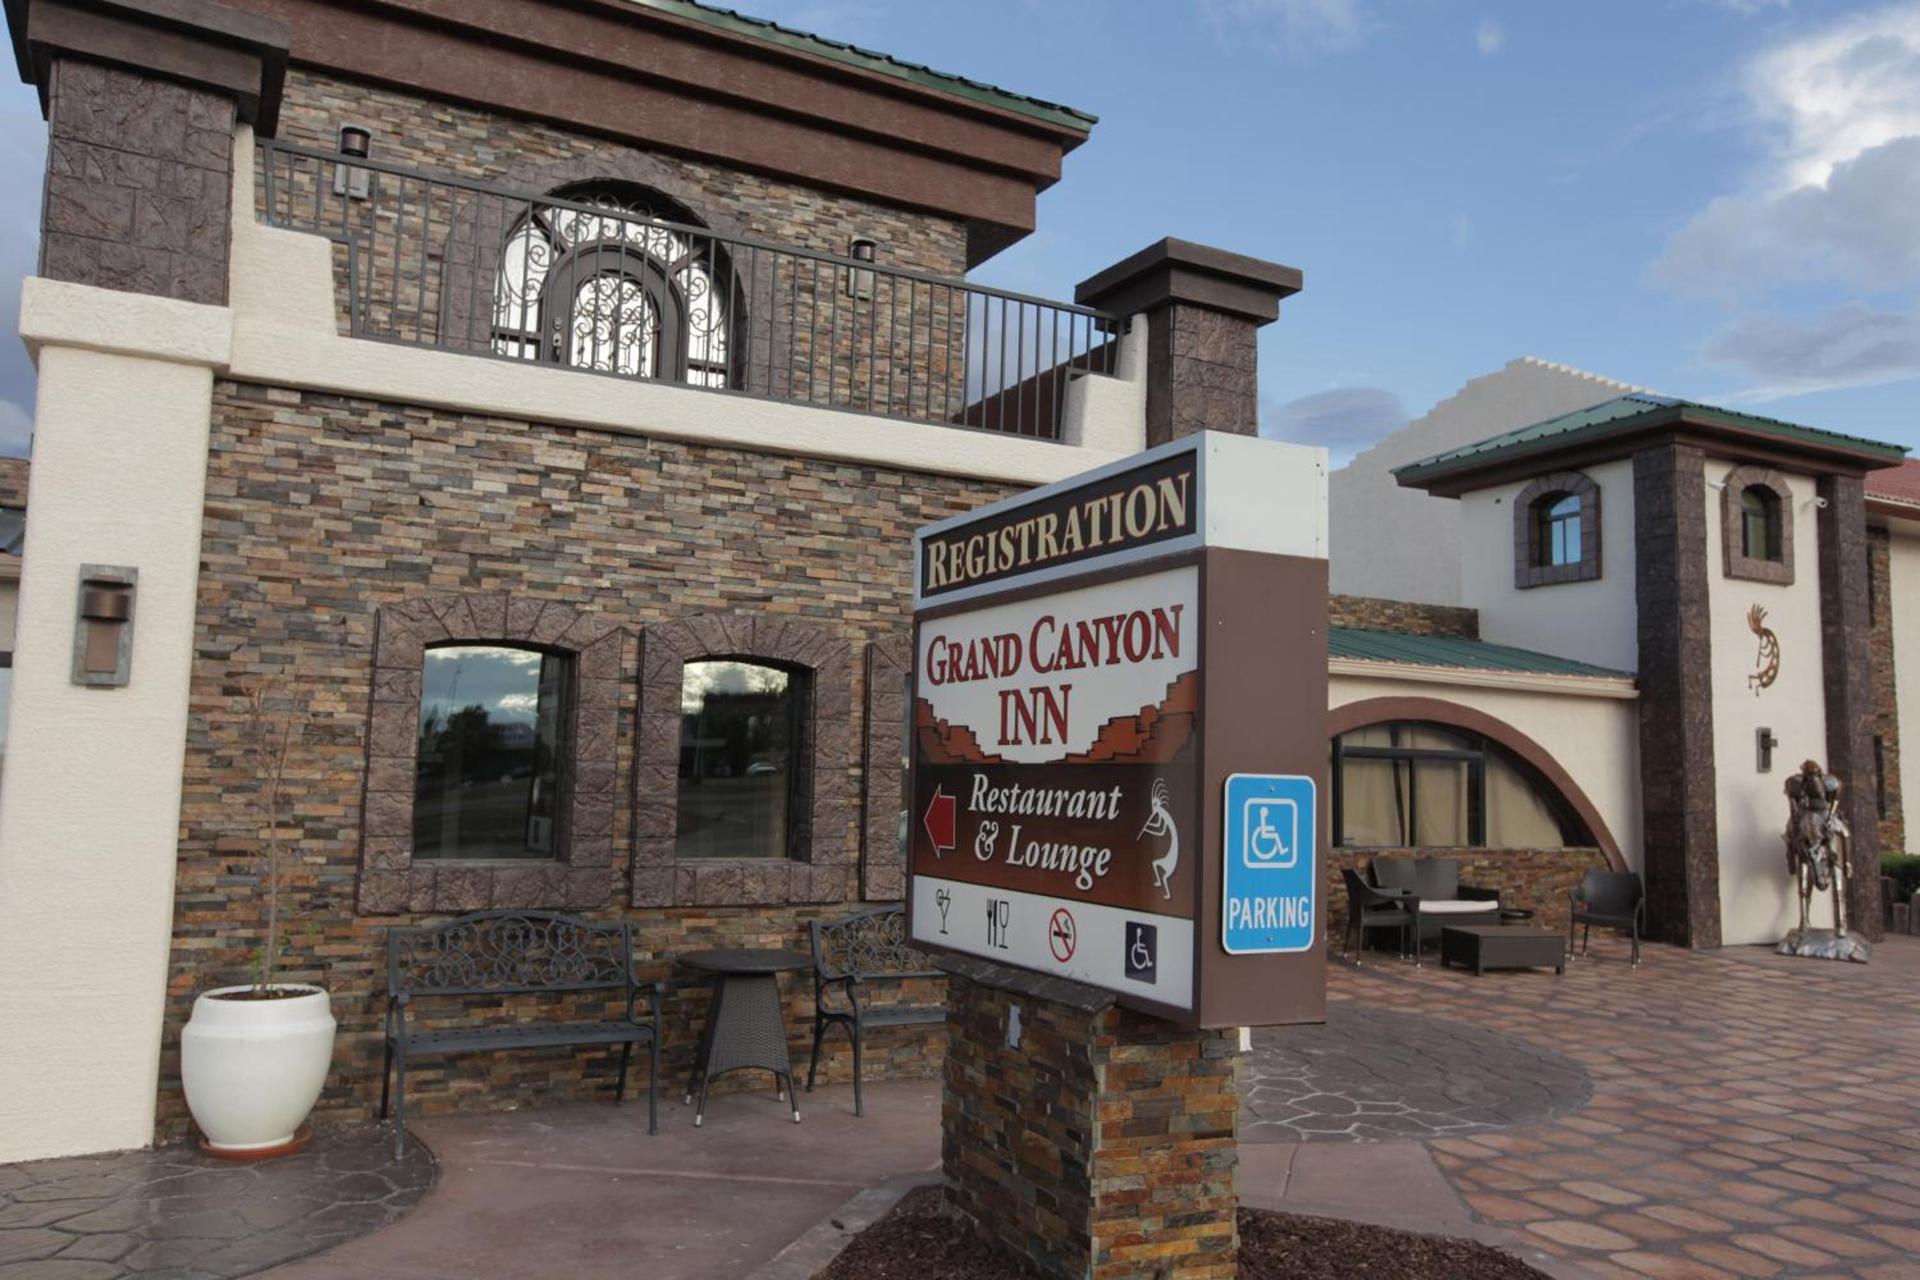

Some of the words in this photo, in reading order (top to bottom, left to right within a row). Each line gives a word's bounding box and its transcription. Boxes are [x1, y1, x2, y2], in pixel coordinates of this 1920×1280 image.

[926, 472, 1190, 590] REGISTRATION
[927, 632, 1022, 686] GRAND
[1029, 604, 1184, 674] CANYON
[998, 684, 1072, 746] INN
[968, 773, 1122, 820] Restaurant
[974, 820, 999, 861] &
[1006, 825, 1111, 890] Lounge
[1228, 896, 1310, 930] PARKING
